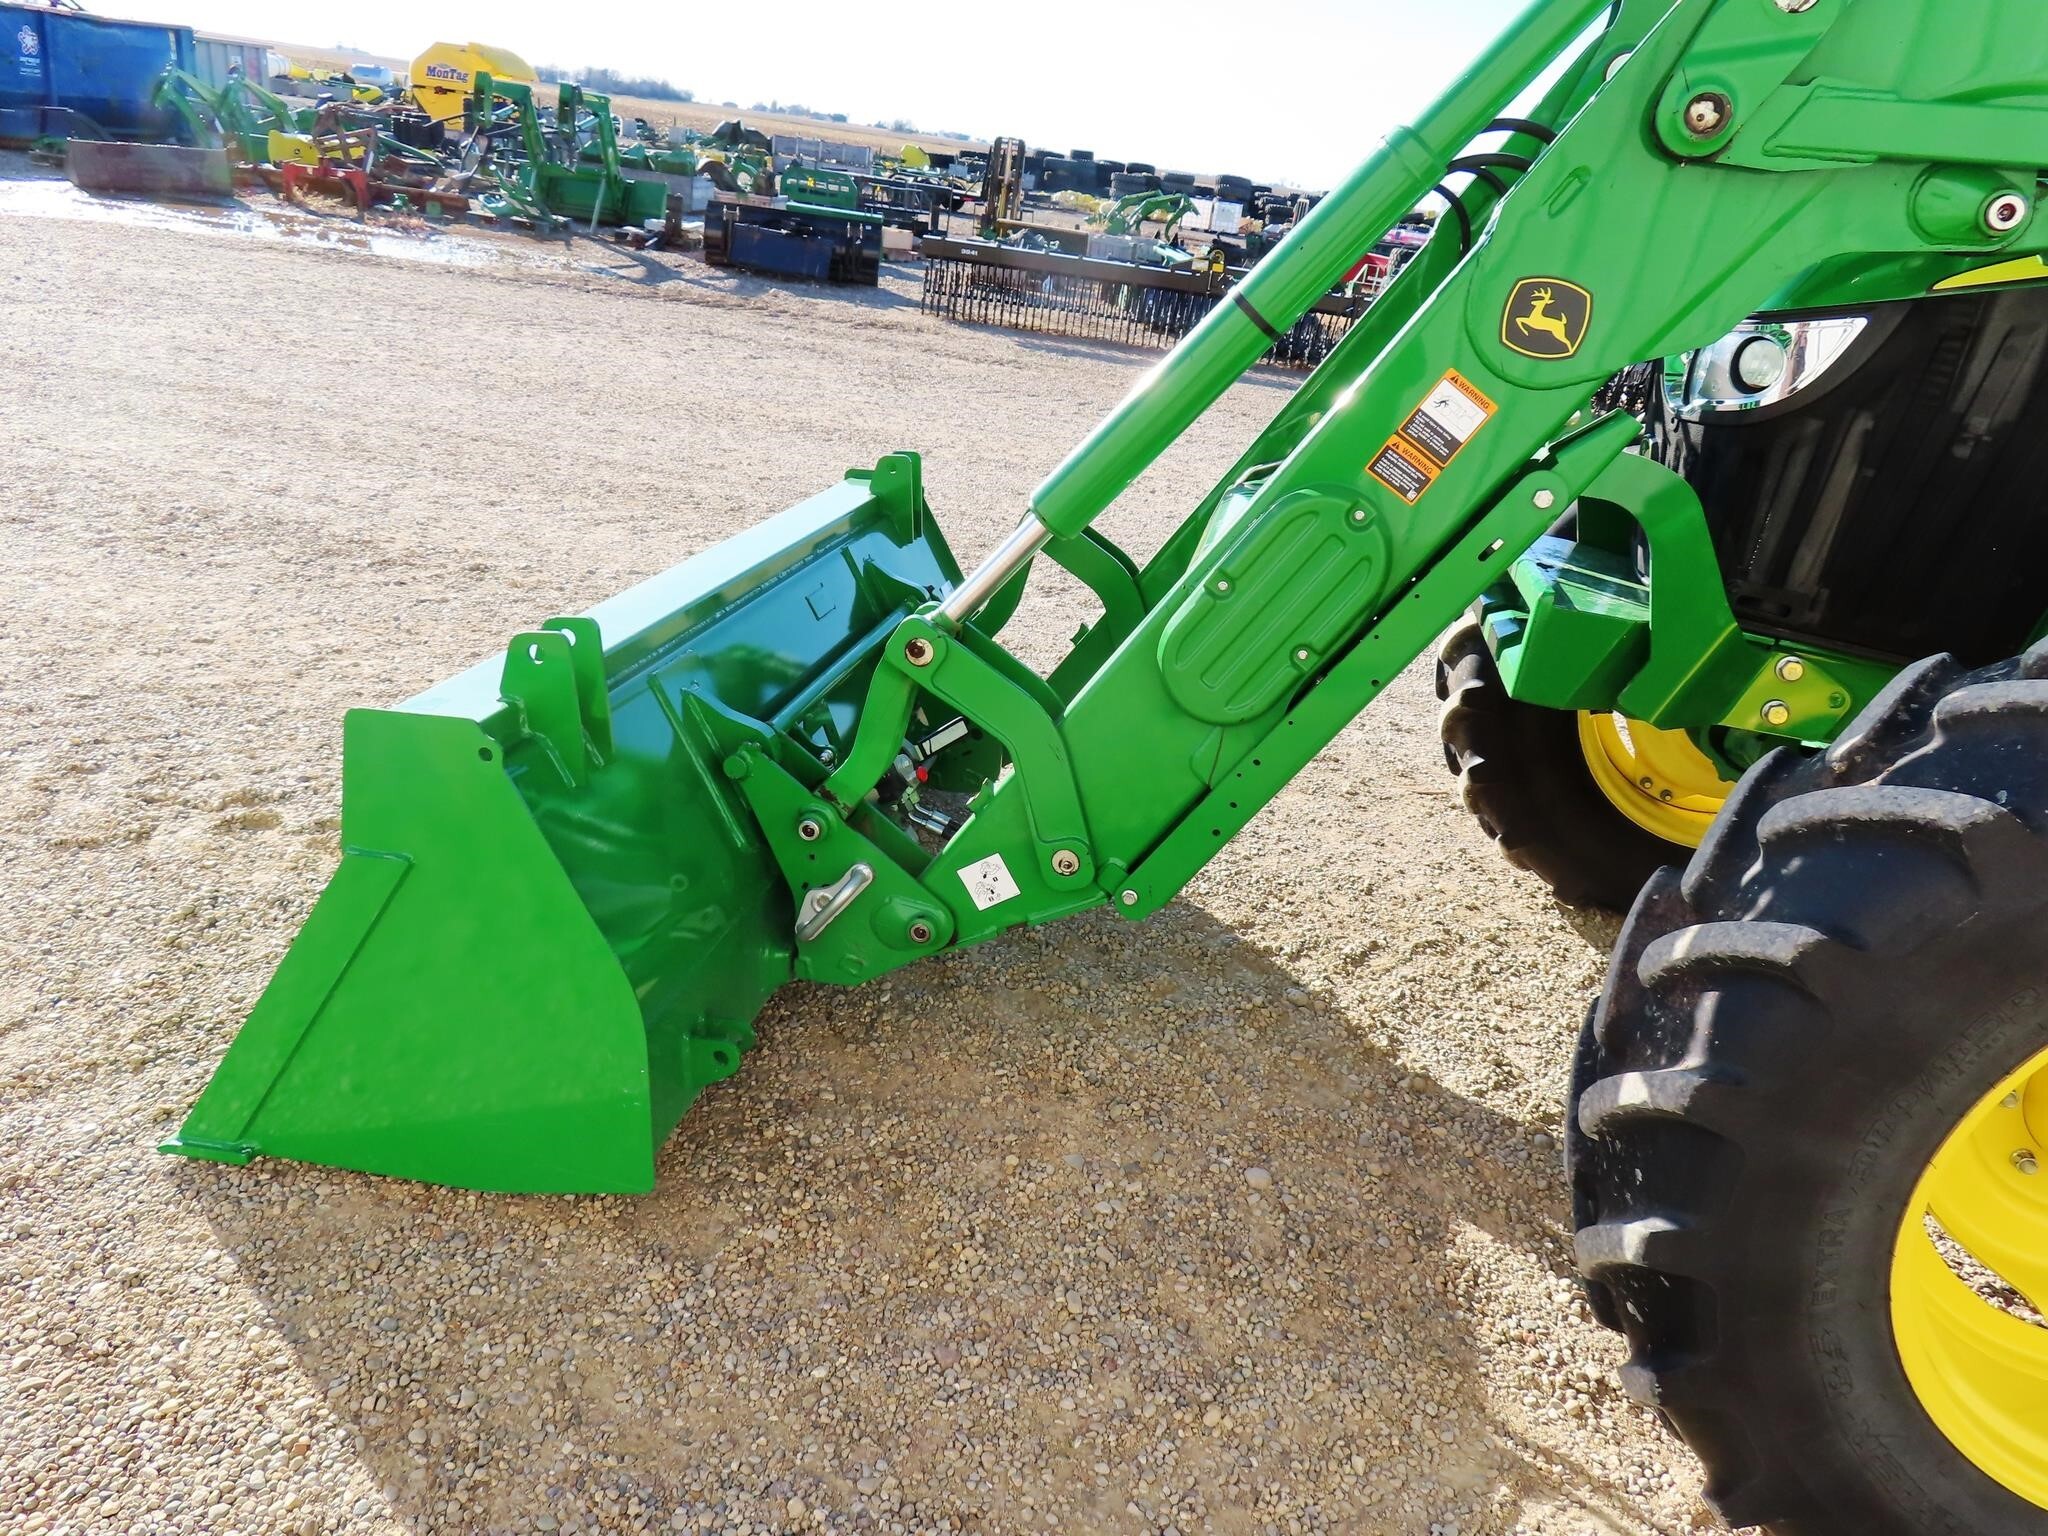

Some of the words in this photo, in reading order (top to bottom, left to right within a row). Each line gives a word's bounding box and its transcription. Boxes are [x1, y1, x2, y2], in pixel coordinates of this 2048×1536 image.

[1457, 379, 1490, 410] WARNING
[1402, 447, 1433, 475] WARNING
[1811, 1206, 1850, 1307] EXTRA
